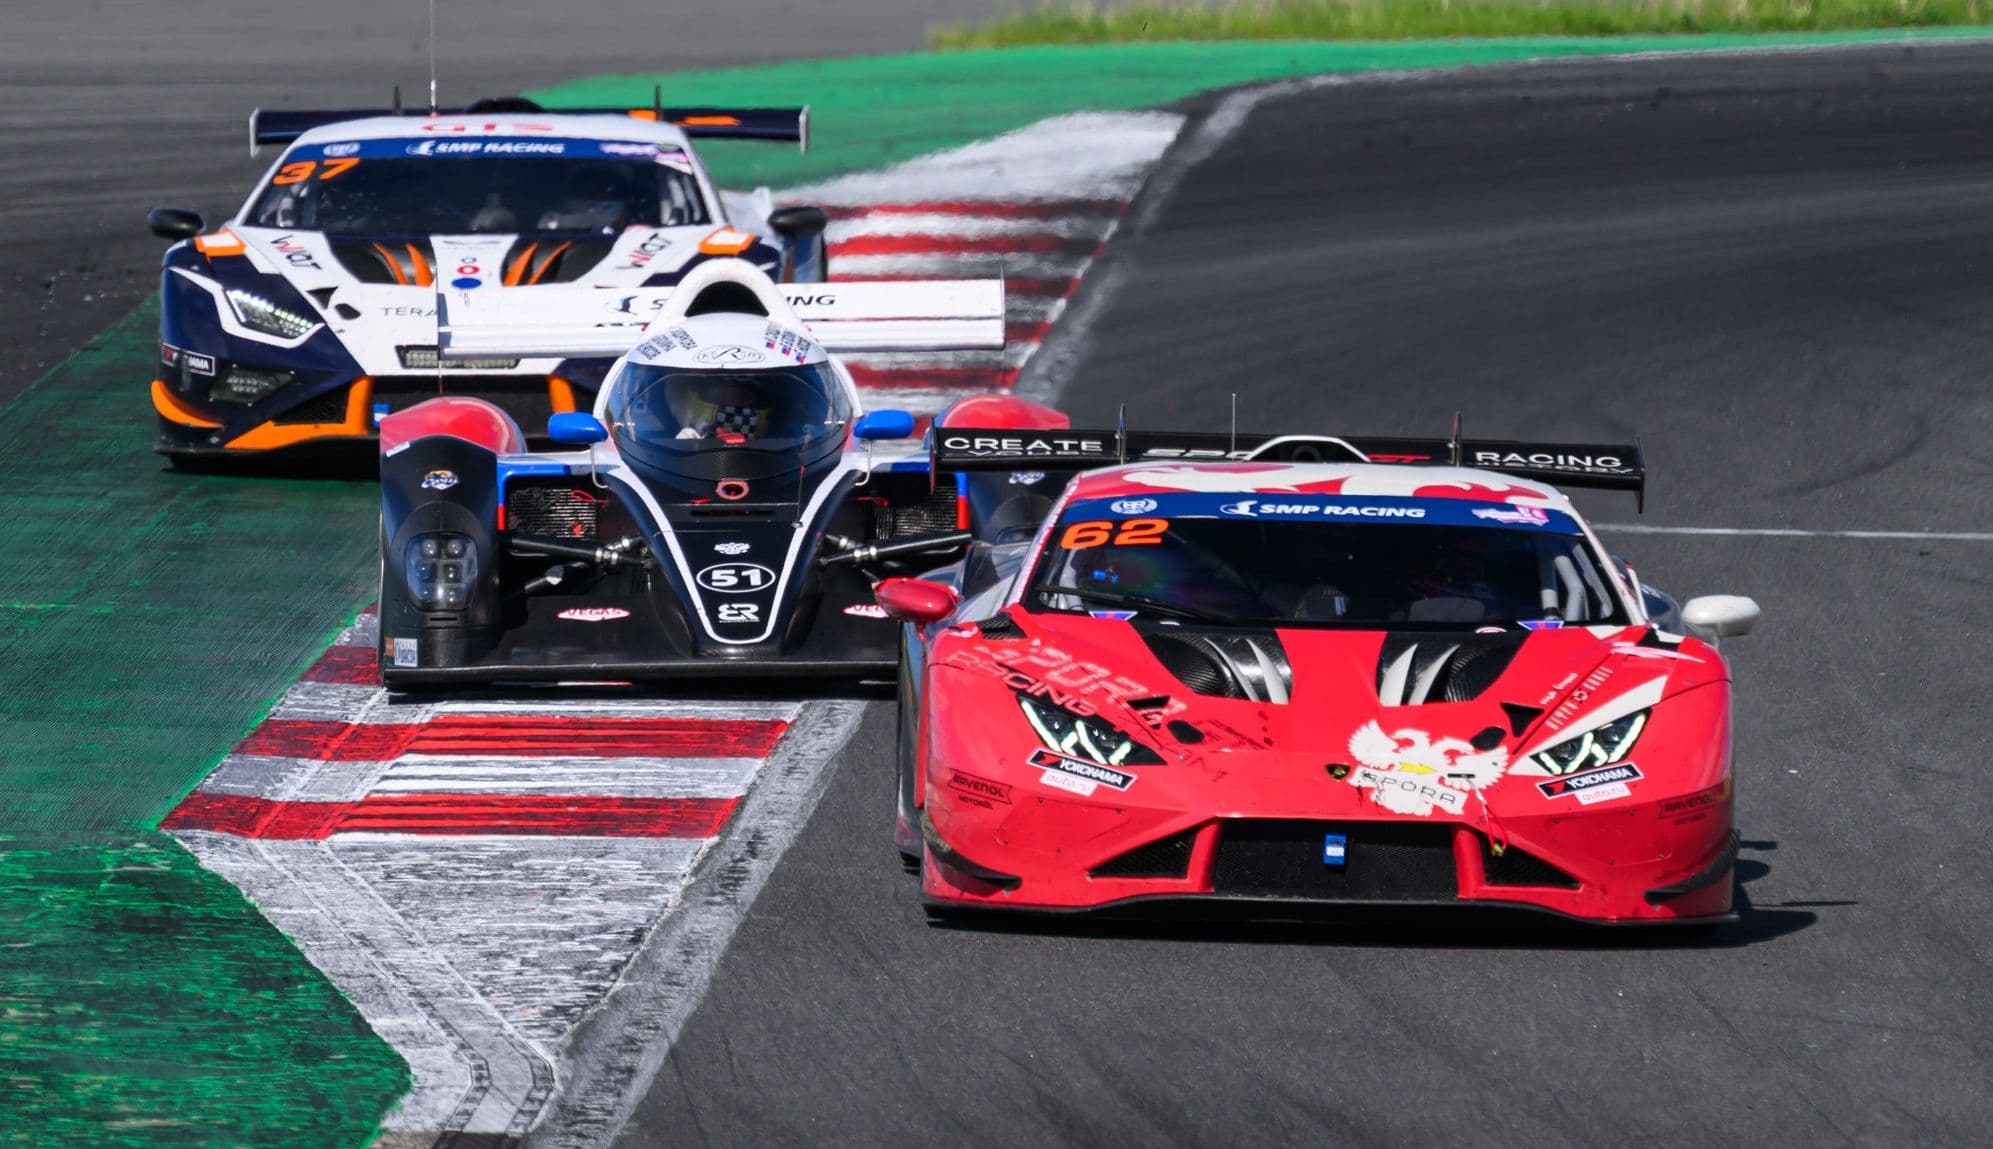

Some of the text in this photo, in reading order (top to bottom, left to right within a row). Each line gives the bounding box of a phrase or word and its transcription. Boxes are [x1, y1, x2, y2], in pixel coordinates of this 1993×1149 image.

[435, 142, 565, 154] SMP RACING
[273, 157, 361, 185] 37
[944, 437, 1103, 452] CREATE
[1475, 451, 1622, 468] RACING
[1259, 503, 1426, 518] SMP RACING
[1061, 518, 1169, 550] 62
[711, 569, 762, 587] 51
[946, 651, 1098, 717] RACING
[1059, 758, 1124, 786] YOKOHAMA
[1566, 768, 1634, 789] YOKOHAMA
